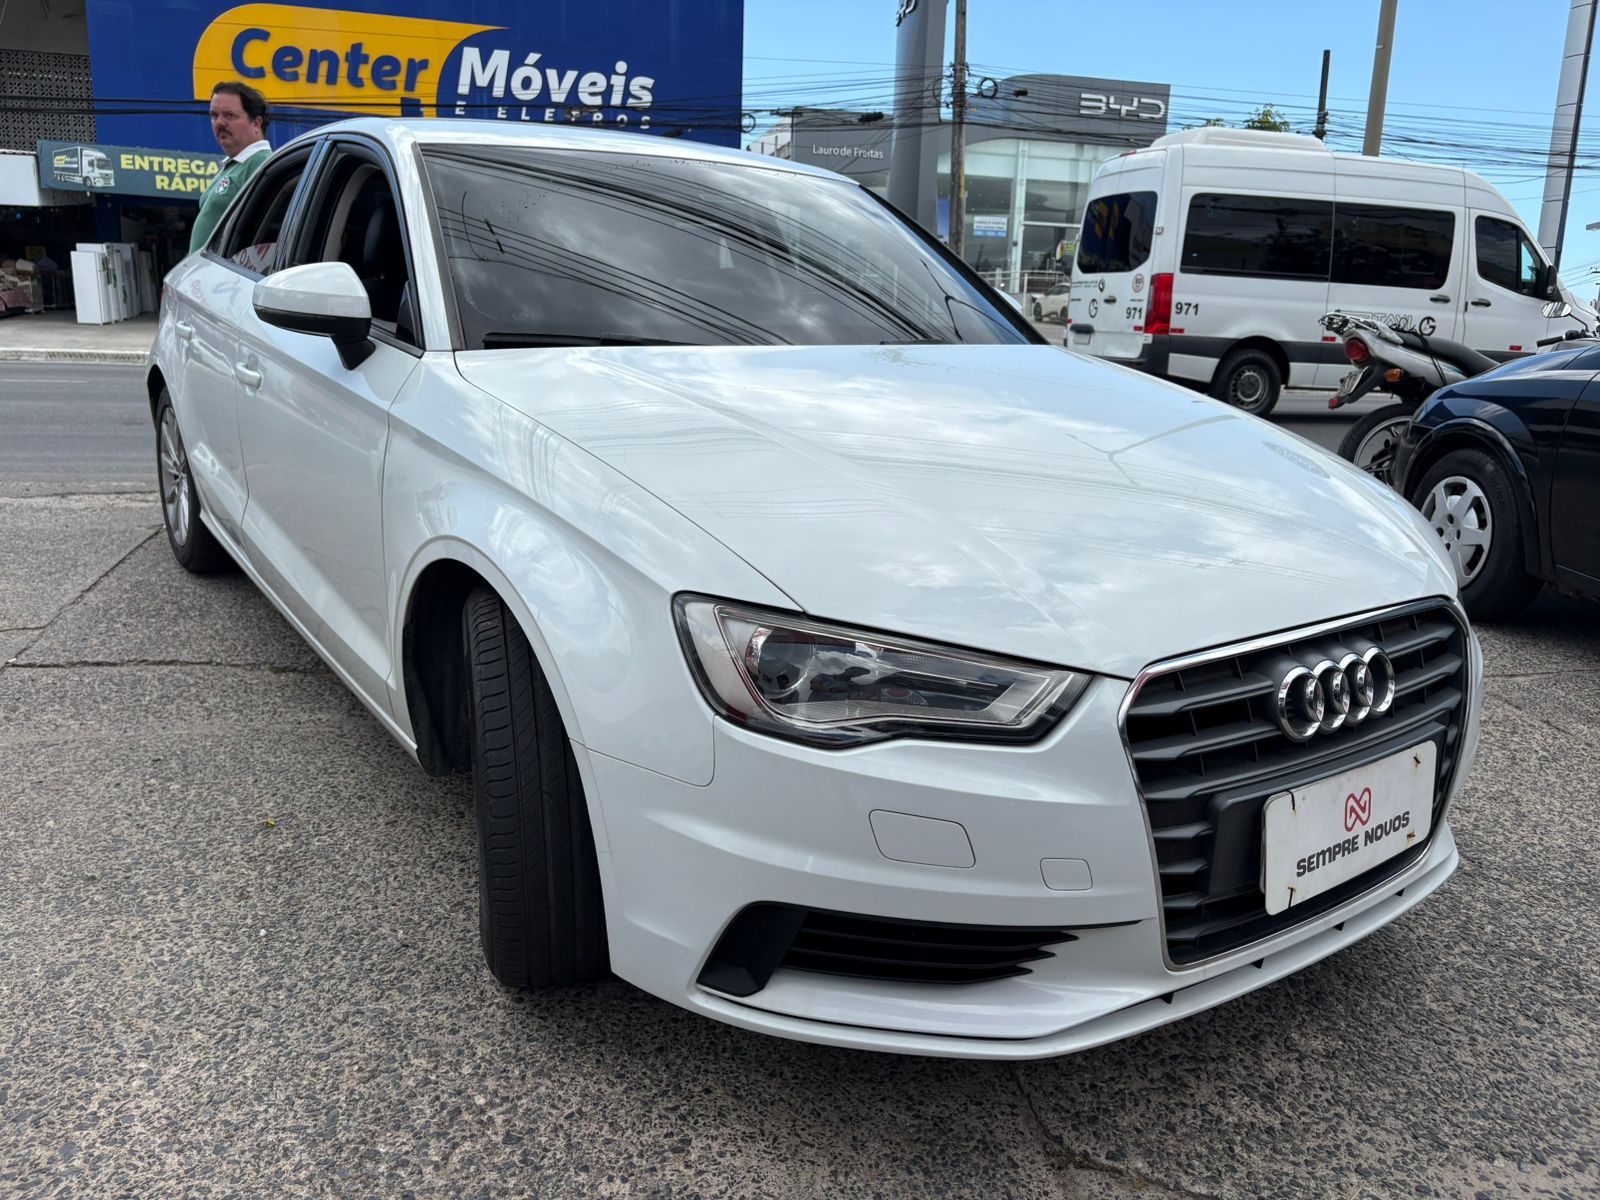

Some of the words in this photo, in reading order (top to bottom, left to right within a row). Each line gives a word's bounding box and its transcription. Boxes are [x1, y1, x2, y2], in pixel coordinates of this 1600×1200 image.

[231, 28, 429, 92] Center
[457, 46, 655, 109] Móveis
[1080, 93, 1165, 119] BYD
[812, 144, 840, 156] Lauro
[840, 147, 852, 157] de
[854, 147, 884, 159] Freitas
[120, 154, 219, 176] ENTREGA
[1126, 307, 1143, 320] 971
[1175, 302, 1199, 316] 971
[1296, 834, 1359, 878] SEMPRE
